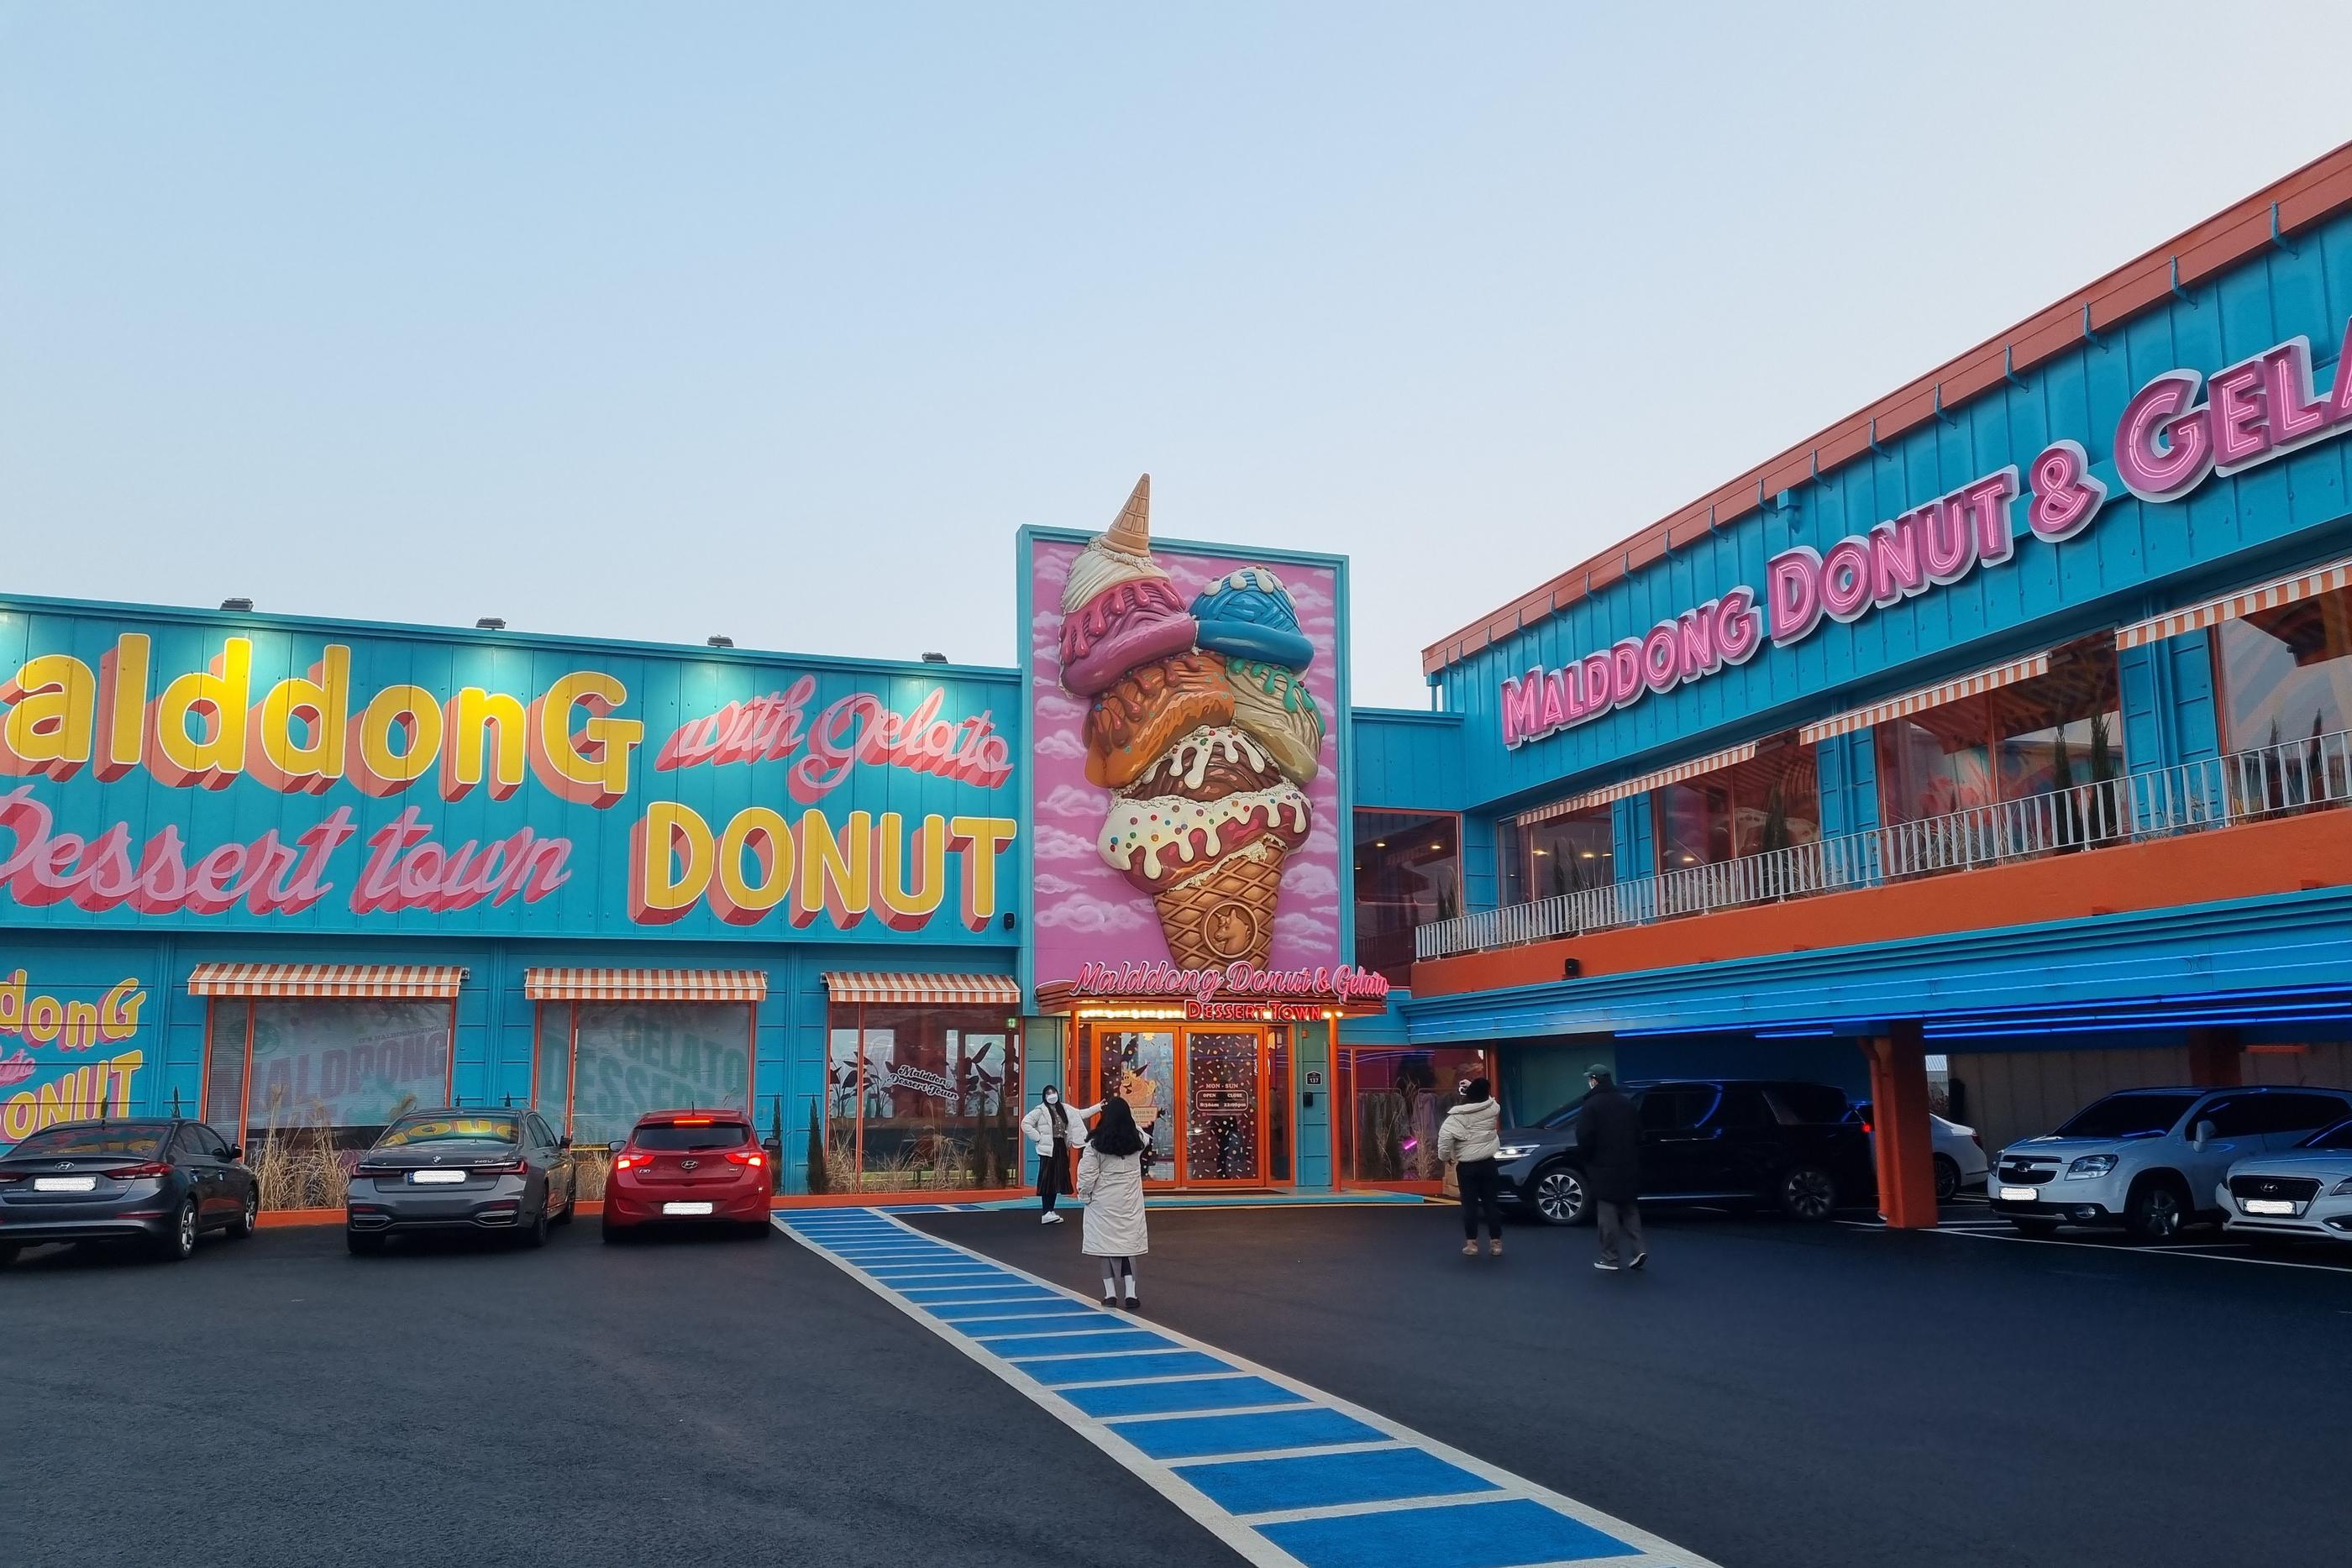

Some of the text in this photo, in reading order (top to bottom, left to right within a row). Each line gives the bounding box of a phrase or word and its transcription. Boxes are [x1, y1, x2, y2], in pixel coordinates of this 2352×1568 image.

[1500, 588, 1759, 748] MALDDONG
[1767, 466, 2017, 645] DONUT
[2027, 441, 2106, 541] &
[660, 674, 816, 766] with
[0, 784, 573, 911] Dessert town
[633, 801, 1016, 926] DONUT
[1069, 960, 1390, 1005] Malddong Donut & Gelato
[1184, 999, 1322, 1022] DESSERT TOWN
[0, 1050, 143, 1141] ONUT
[887, 1073, 927, 1092] Dessert
[898, 1064, 953, 1089] Malddong
